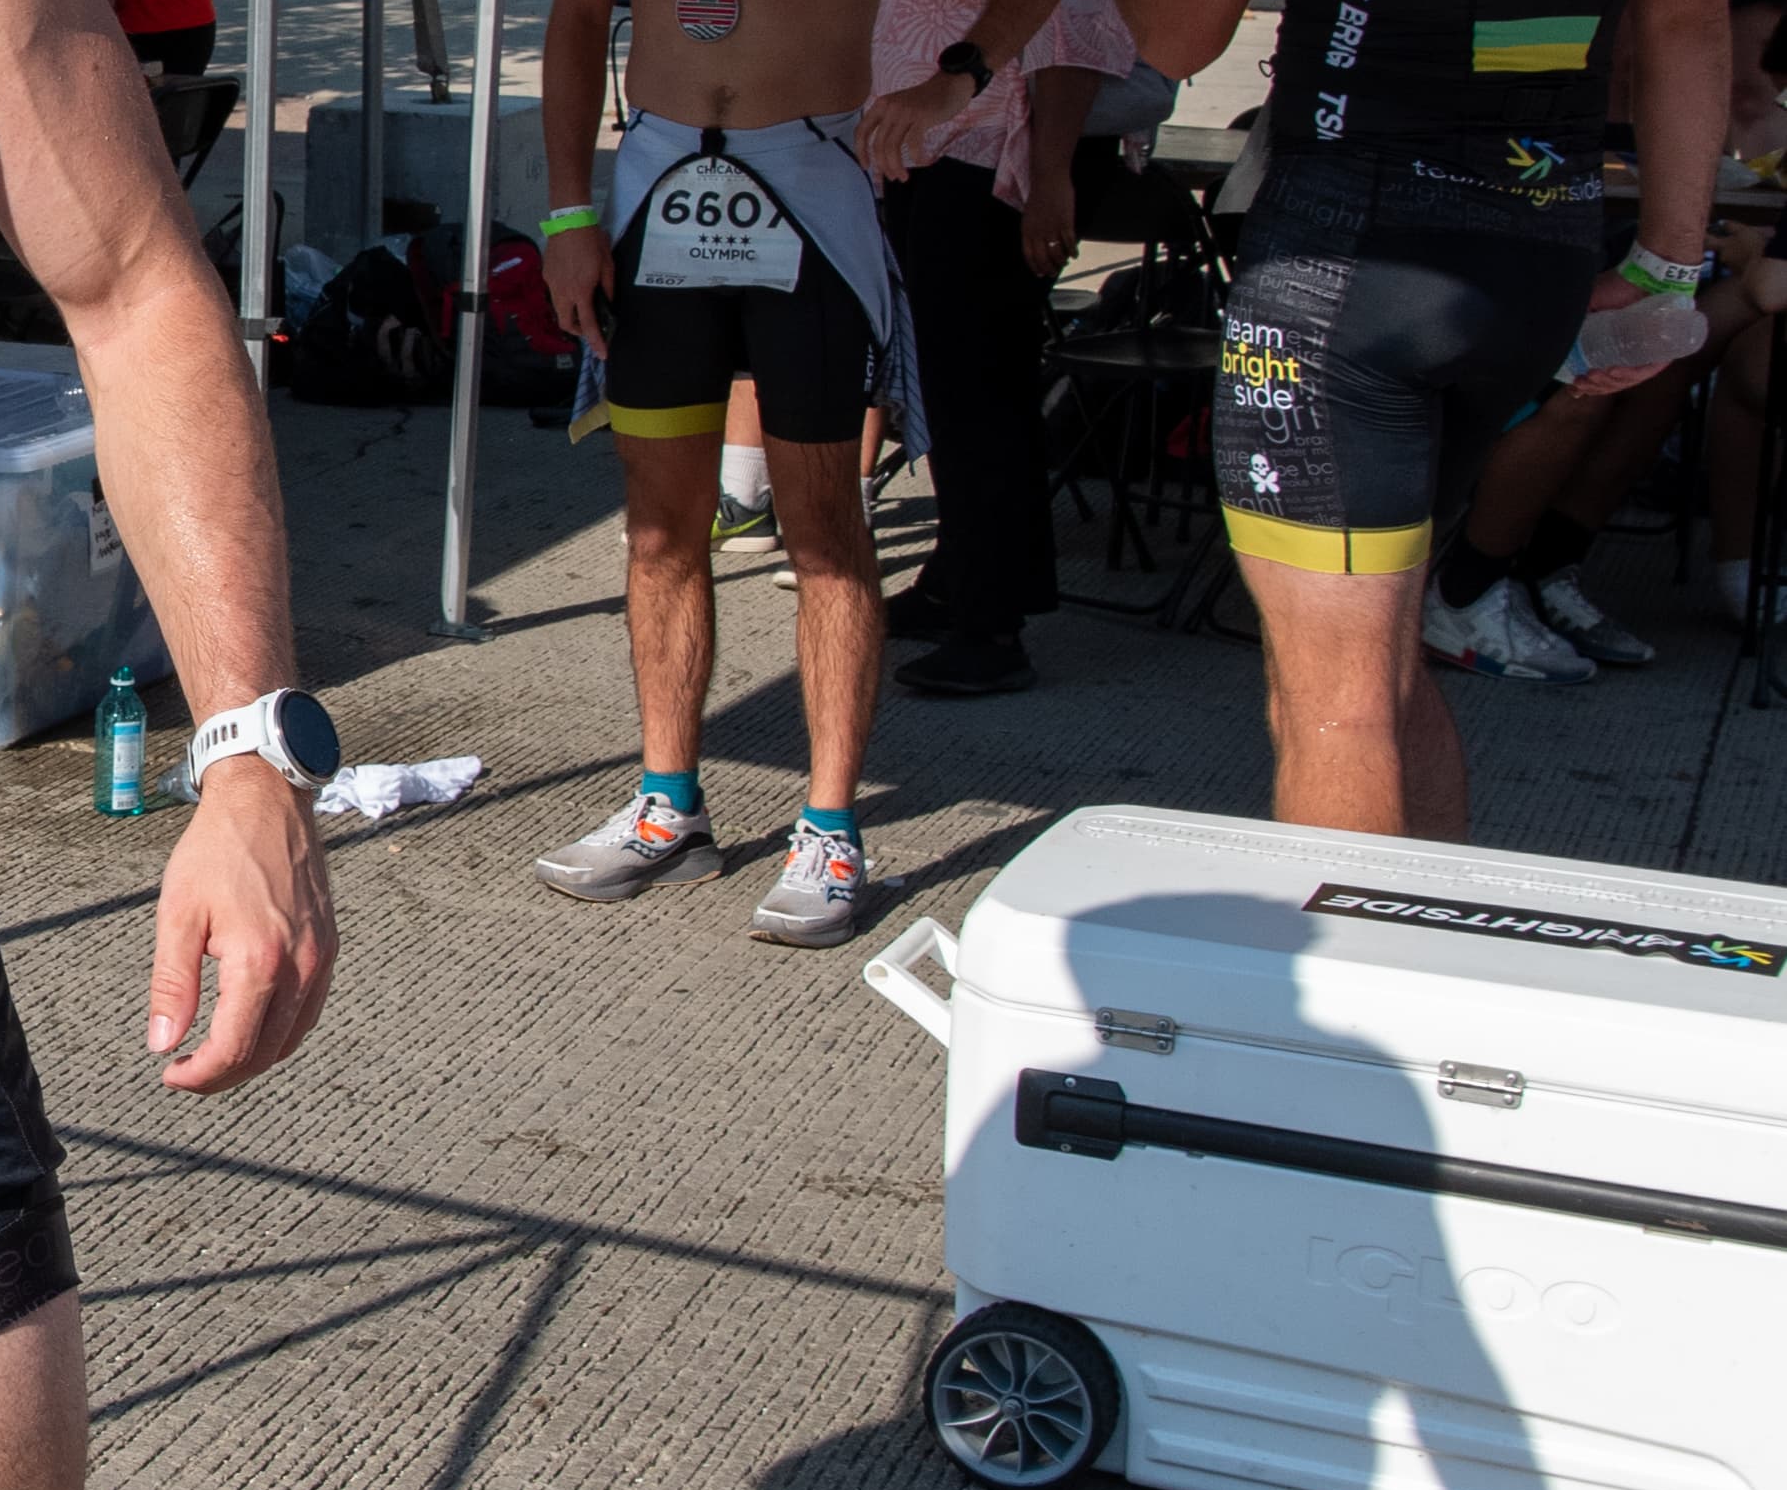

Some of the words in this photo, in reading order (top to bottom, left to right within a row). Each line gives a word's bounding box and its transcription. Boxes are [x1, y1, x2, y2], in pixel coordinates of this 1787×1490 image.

[689, 247, 756, 262] OLYMPIC
[645, 277, 685, 286] 6607
[1225, 314, 1284, 349] team
[1222, 340, 1302, 387] bright
[1233, 377, 1293, 410] side
[1320, 893, 1686, 949] BRIGHTSIDE
[1307, 1235, 1623, 1336] IGLOO
